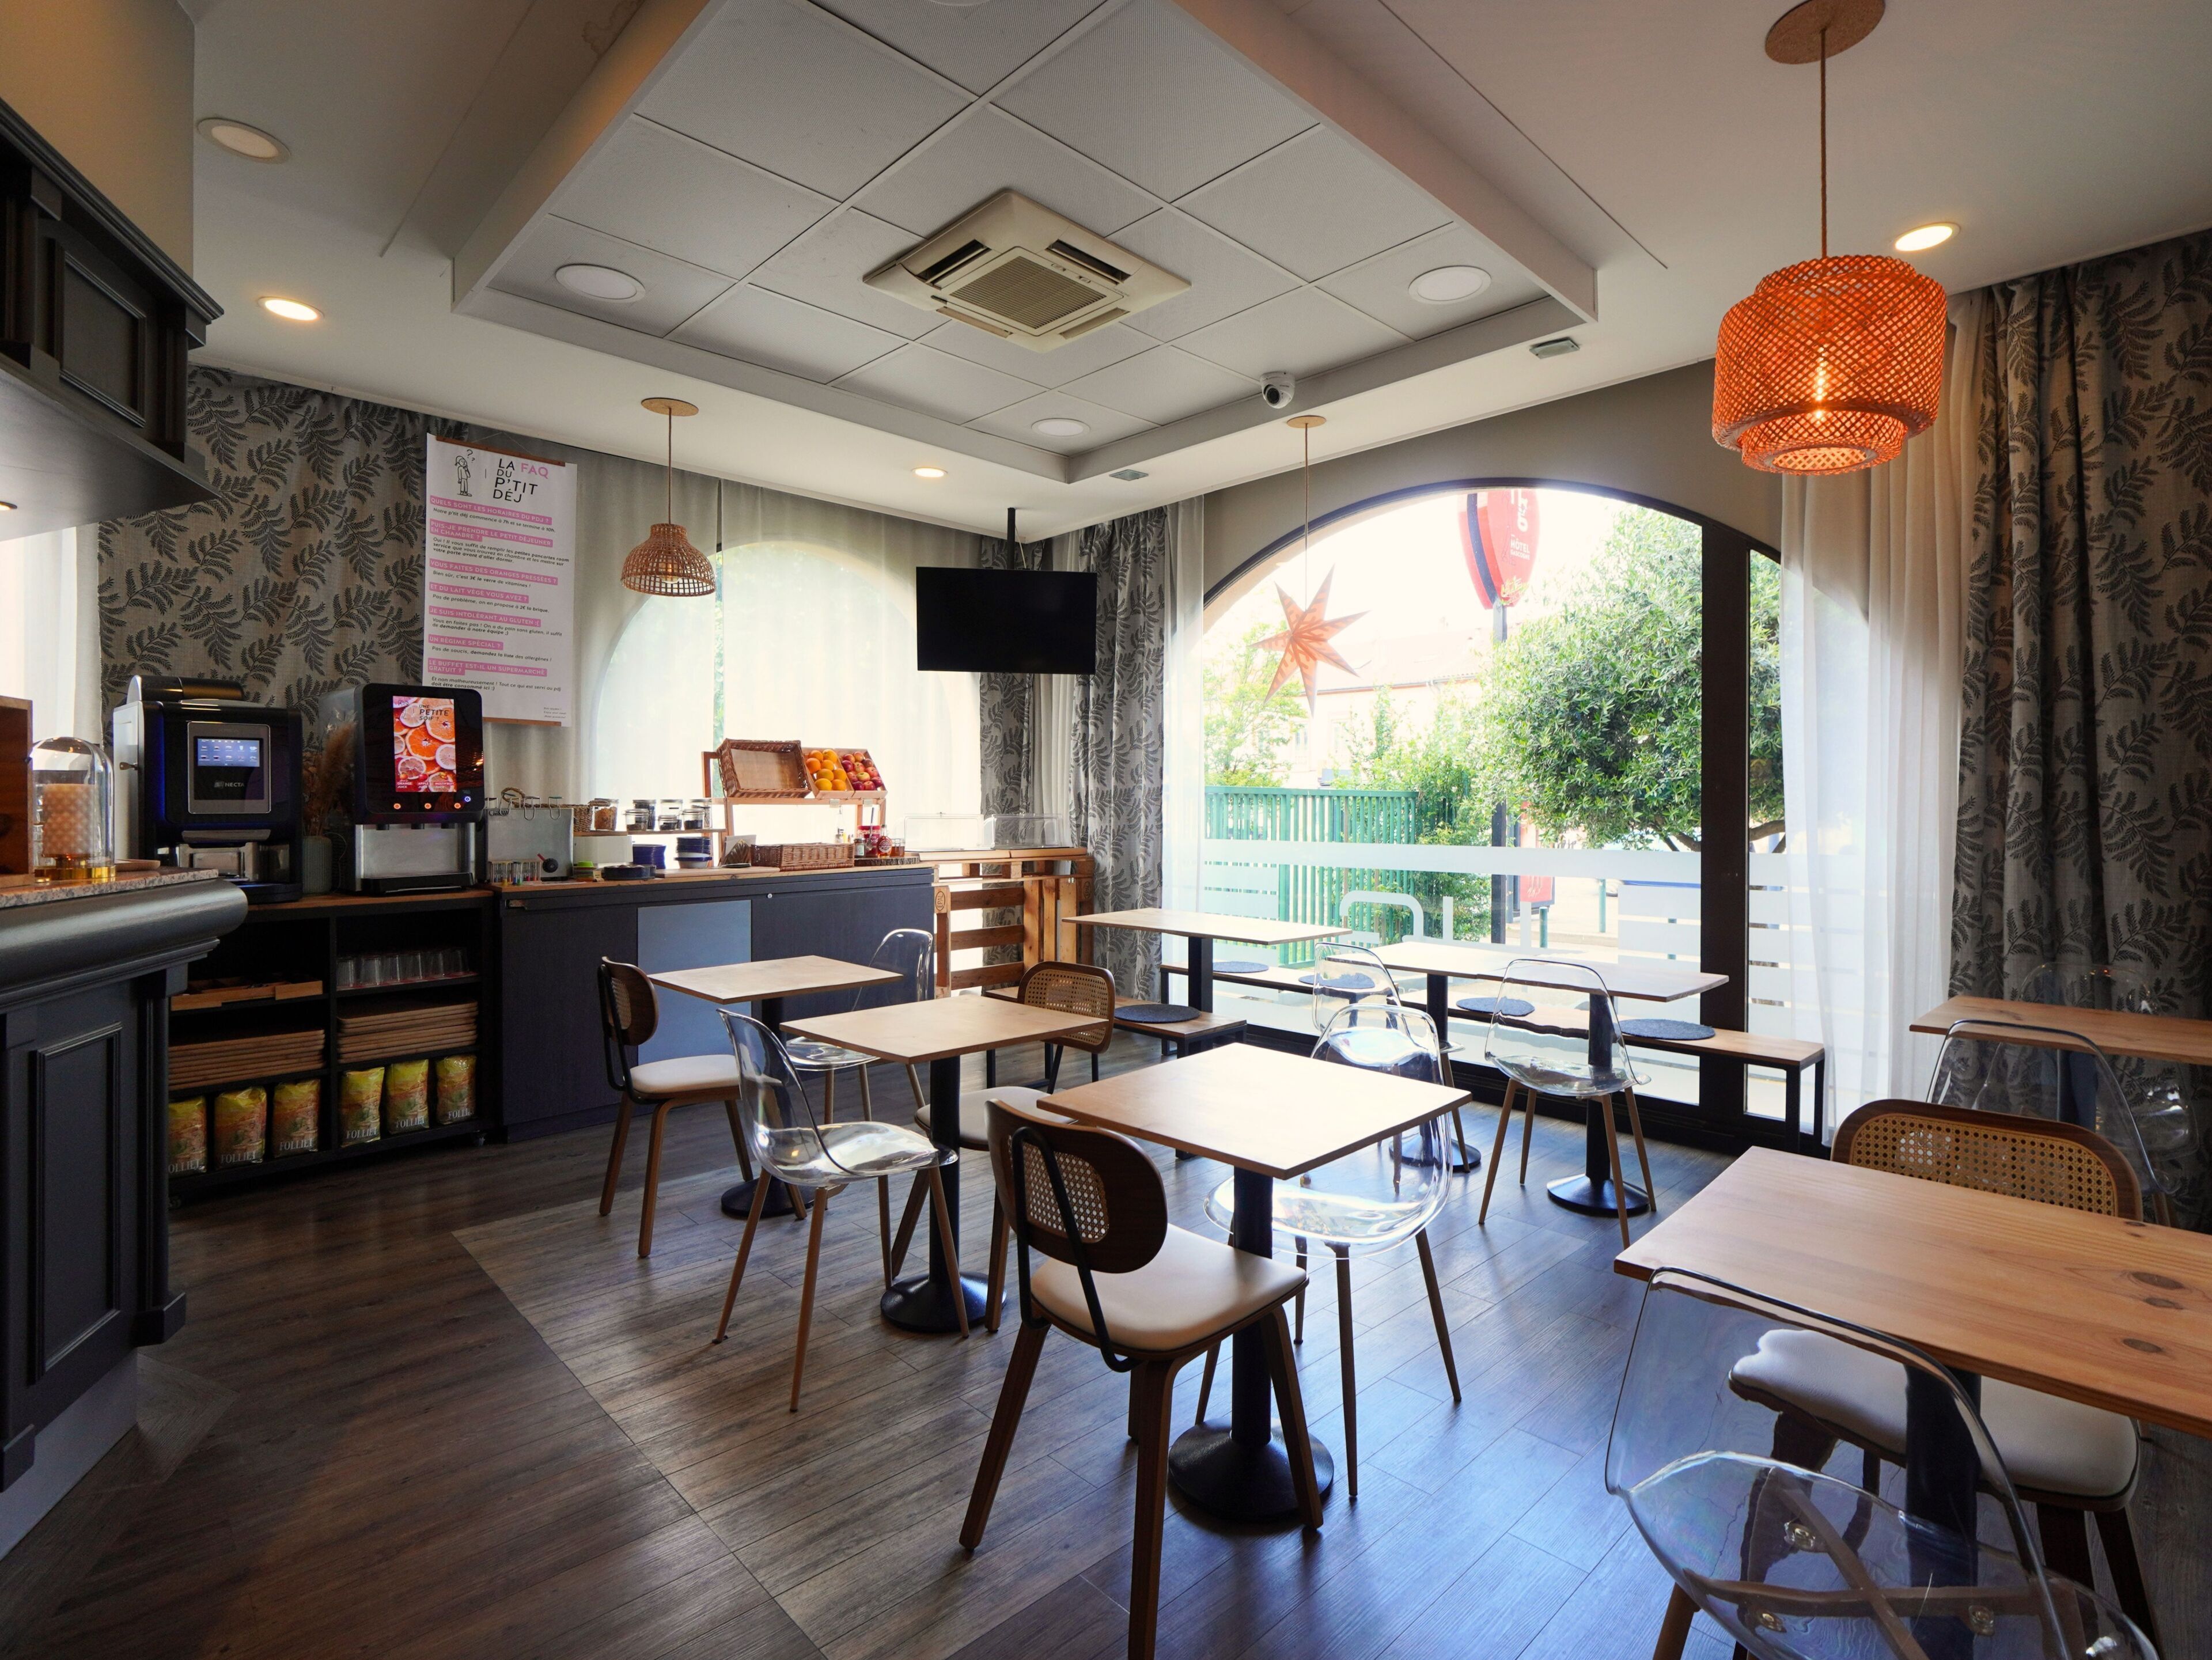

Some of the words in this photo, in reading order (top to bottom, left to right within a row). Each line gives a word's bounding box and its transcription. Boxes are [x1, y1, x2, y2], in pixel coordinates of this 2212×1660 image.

[497, 469, 512, 478] DU
[498, 458, 515, 471] LA
[521, 463, 548, 479] FAQ
[495, 477, 538, 495] P'TIT
[493, 488, 522, 503] DÉJ
[431, 497, 451, 507] QUELS
[453, 502, 471, 510] SONT
[487, 507, 519, 518] HORAIRES
[469, 514, 497, 522] commence
[431, 521, 455, 530] PUIS-JE
[458, 525, 488, 536] PRENDRE
[519, 535, 550, 545] DÉJEUNER
[440, 529, 474, 539] CHAMBRE
[1510, 538, 1531, 554] HÔTEL
[449, 563, 472, 571] FAITES
[490, 569, 520, 578] ORANGES
[521, 574, 551, 583] PRESSÉES
[467, 588, 484, 596] VÉGÉ
[450, 596, 476, 604] problème,
[456, 610, 497, 620] INTOLÉRANT
[440, 636, 465, 645] RÉGIME
[468, 639, 494, 647] SPÉCIAL
[498, 665, 544, 674] SUPERMARCHÉ
[449, 678, 494, 687] malheureusement
[396, 1115, 425, 1128] FOLLIET
[346, 1128, 377, 1139] FOLLIET
[279, 1138, 314, 1151] FOLLIET
[221, 1151, 256, 1163] FOLLIET
[168, 1159, 200, 1173] OLLIET
